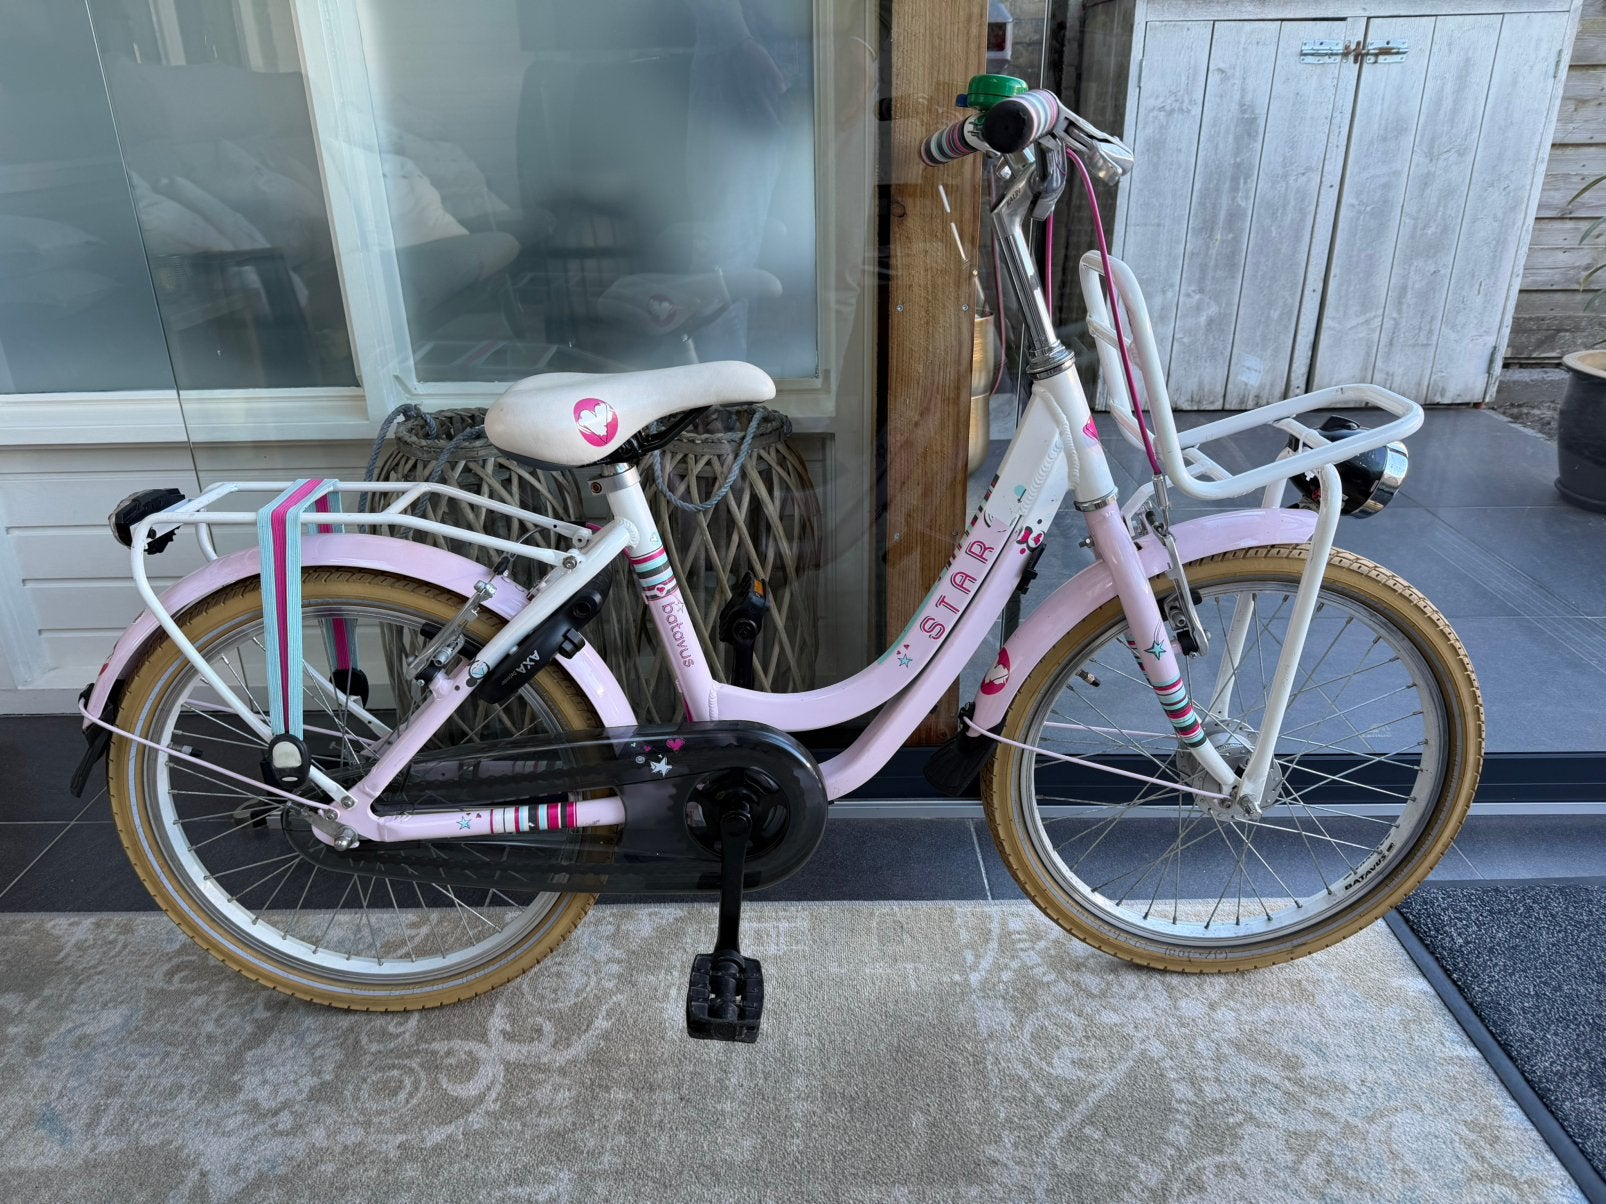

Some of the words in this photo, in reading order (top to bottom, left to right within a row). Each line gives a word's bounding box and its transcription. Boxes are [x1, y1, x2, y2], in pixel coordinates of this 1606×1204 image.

[920, 540, 994, 640] STAR
[662, 601, 694, 668] batavus
[515, 649, 540, 674] AXA
[1344, 854, 1387, 890] BATAVUS
